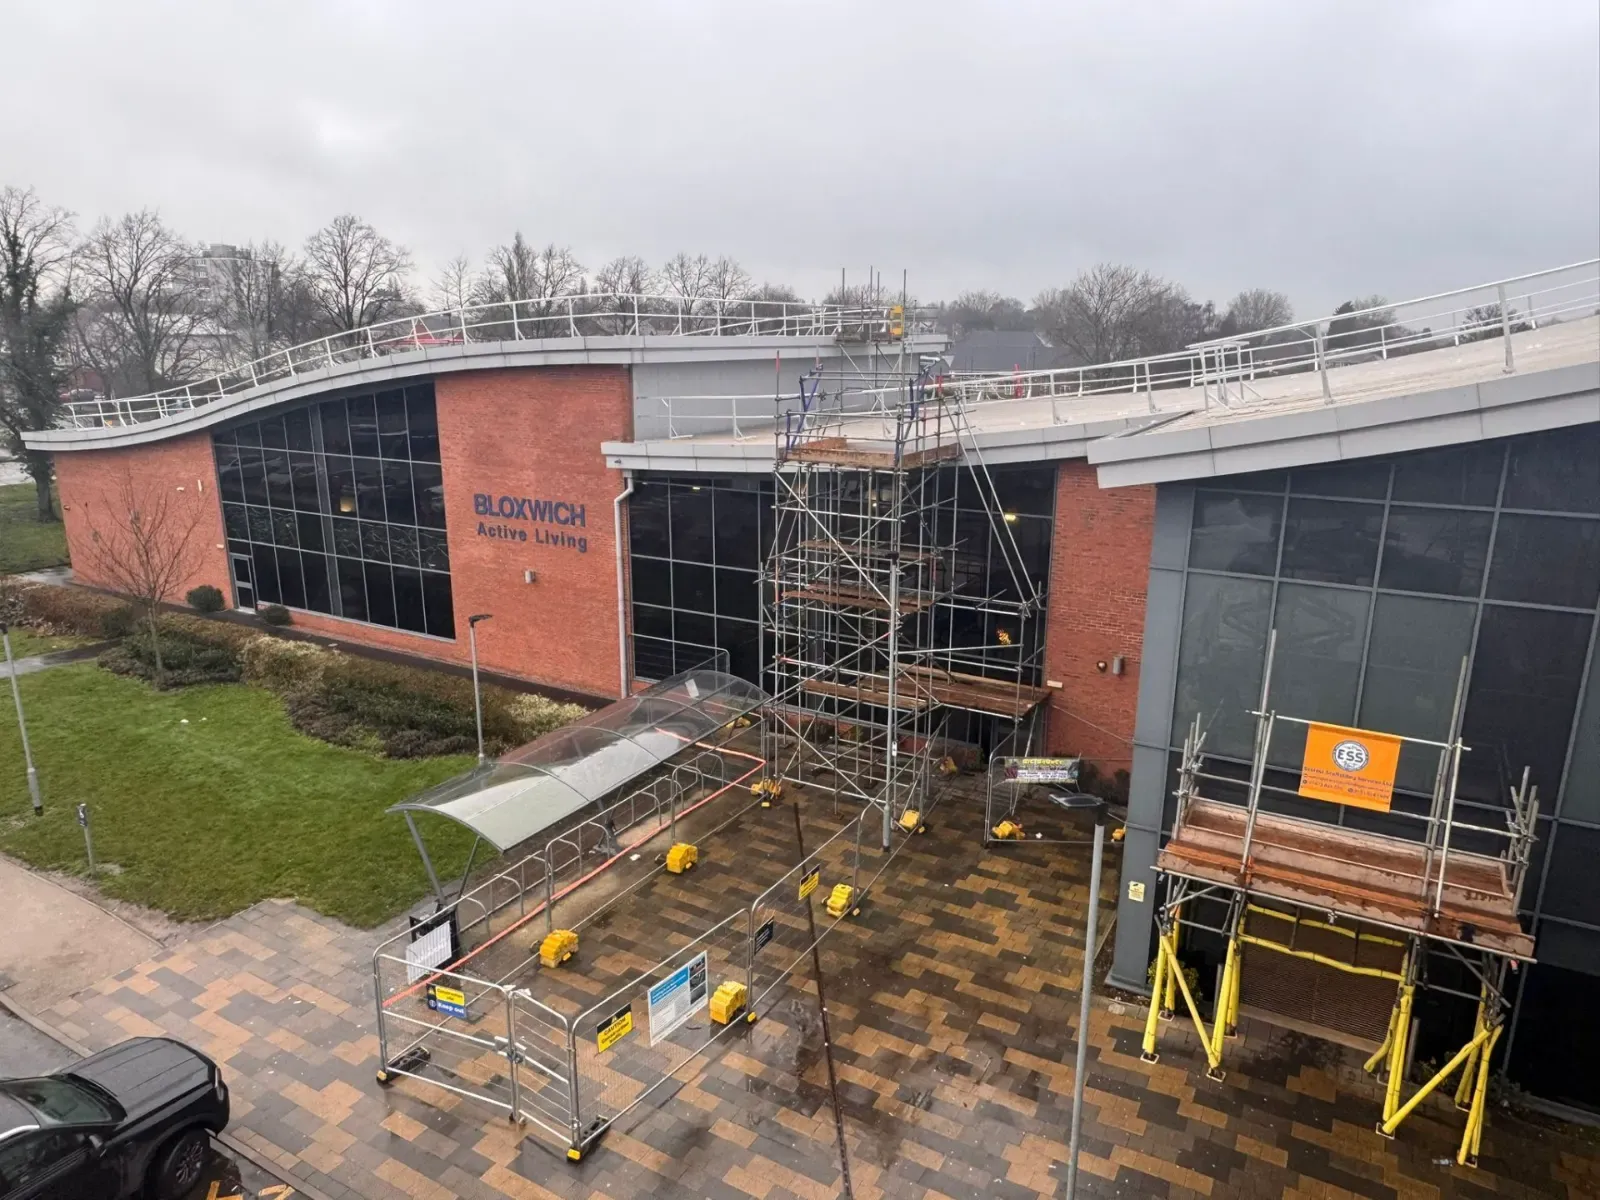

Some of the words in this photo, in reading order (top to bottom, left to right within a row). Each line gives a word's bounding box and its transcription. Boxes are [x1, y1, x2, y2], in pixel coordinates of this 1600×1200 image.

[474, 493, 586, 528] BLOXWICH
[477, 521, 528, 542] Active
[535, 528, 588, 553] Living
[1337, 749, 1364, 763] ESS
[438, 1002, 453, 1011] Keep
[604, 1017, 626, 1035] CAUTION
